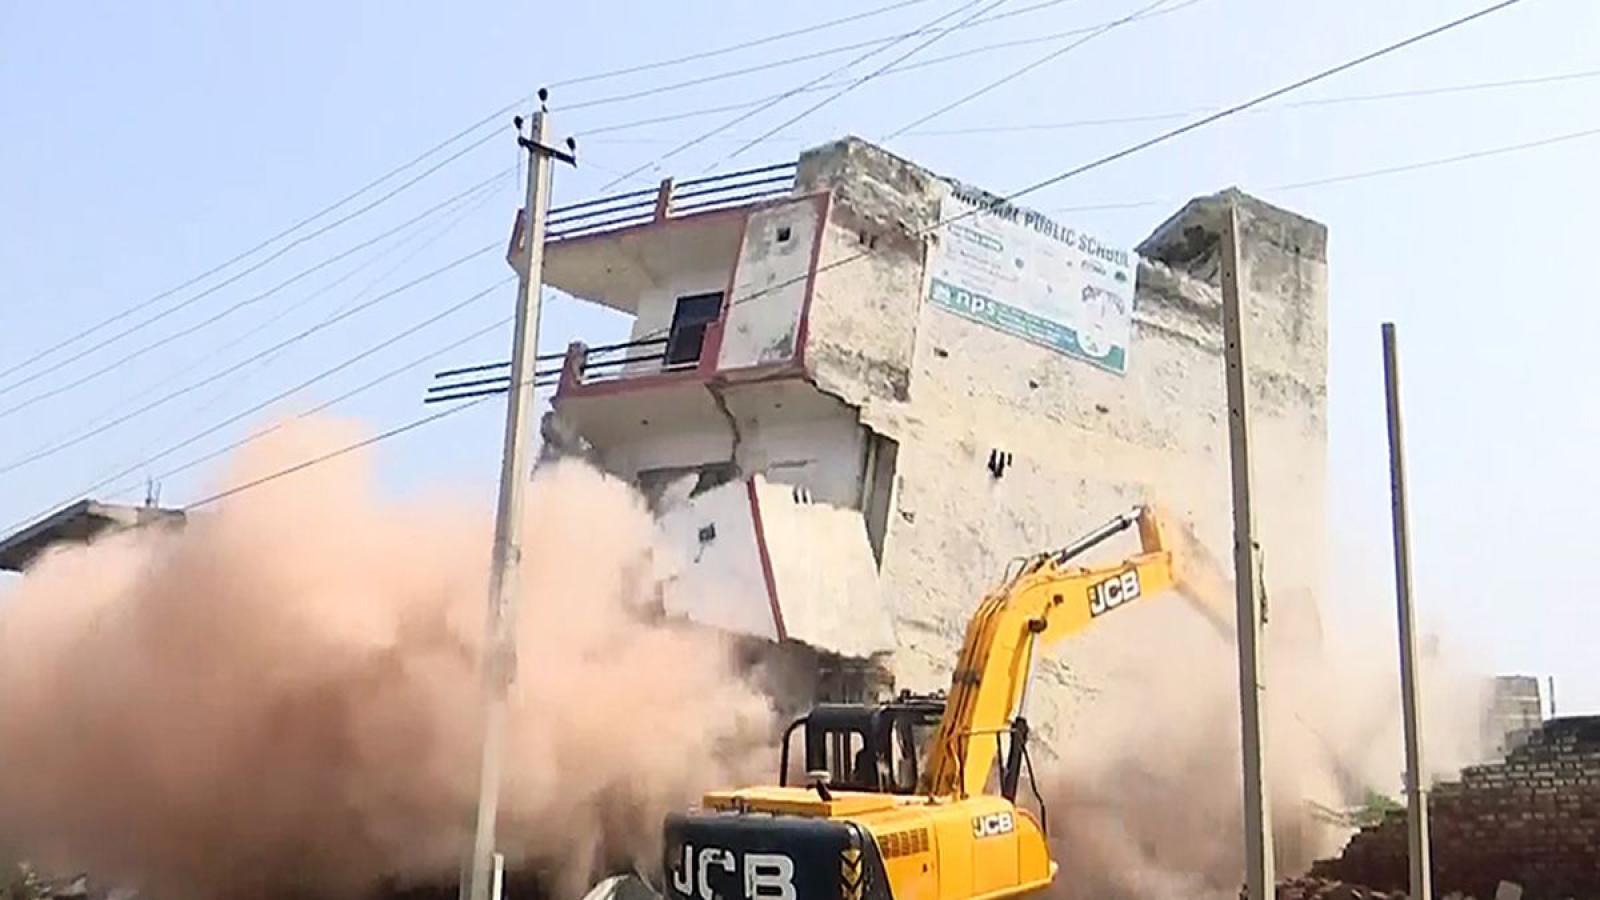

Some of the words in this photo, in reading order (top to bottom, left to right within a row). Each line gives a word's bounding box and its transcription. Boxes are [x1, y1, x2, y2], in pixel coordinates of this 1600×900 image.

[1024, 210, 1075, 247] PUBLIC
[956, 290, 997, 317] nps
[1088, 570, 1139, 614] JCB
[973, 813, 1013, 836] JCB
[673, 844, 797, 900] JCB
